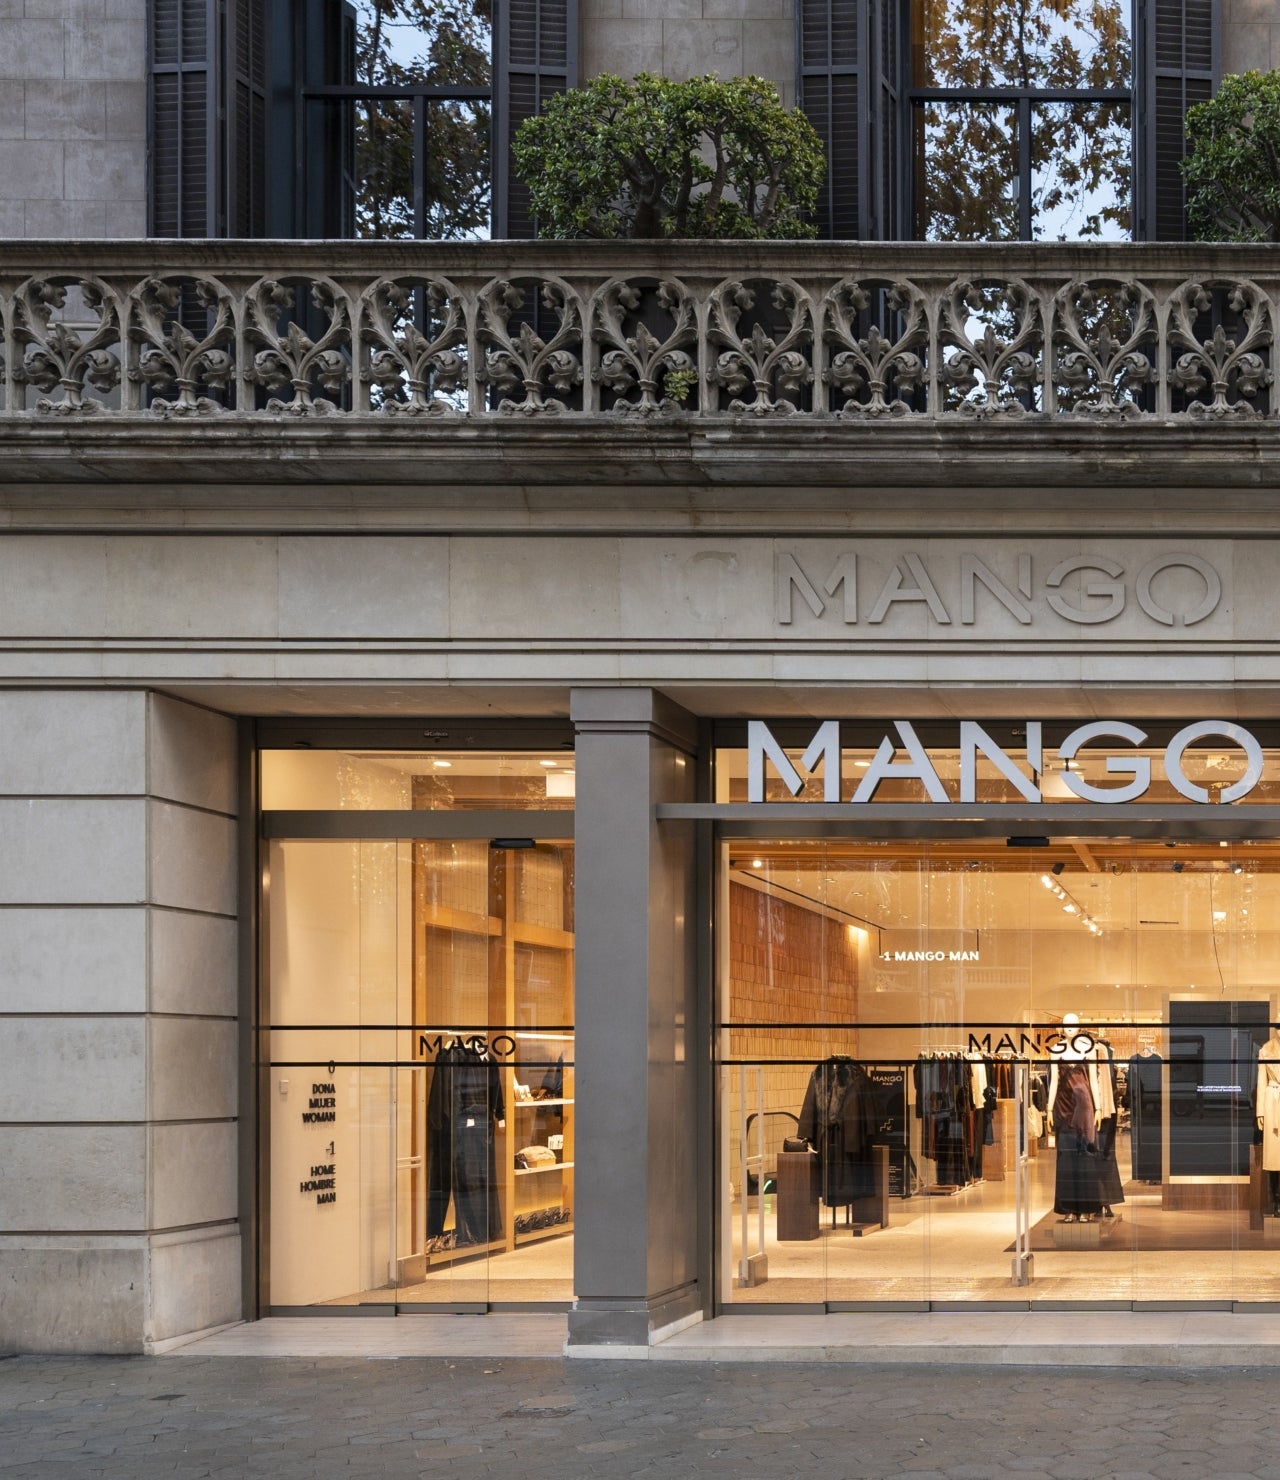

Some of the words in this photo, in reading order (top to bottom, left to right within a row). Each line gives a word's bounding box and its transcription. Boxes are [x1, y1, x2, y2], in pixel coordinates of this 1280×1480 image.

[778, 552, 1222, 627] MANGO
[747, 720, 1265, 804] MANGO
[879, 951, 891, 961] -1
[894, 951, 945, 961] MANGO
[949, 951, 979, 961] MAN
[968, 1033, 1095, 1054] MANGO
[312, 1084, 336, 1094] DONA
[309, 1098, 336, 1108] MUJER
[302, 1112, 336, 1123] WOMAN
[325, 1141, 336, 1155] -1
[310, 1164, 336, 1176] HOME
[300, 1178, 336, 1192] HOMBRE
[317, 1192, 336, 1204] MAN
